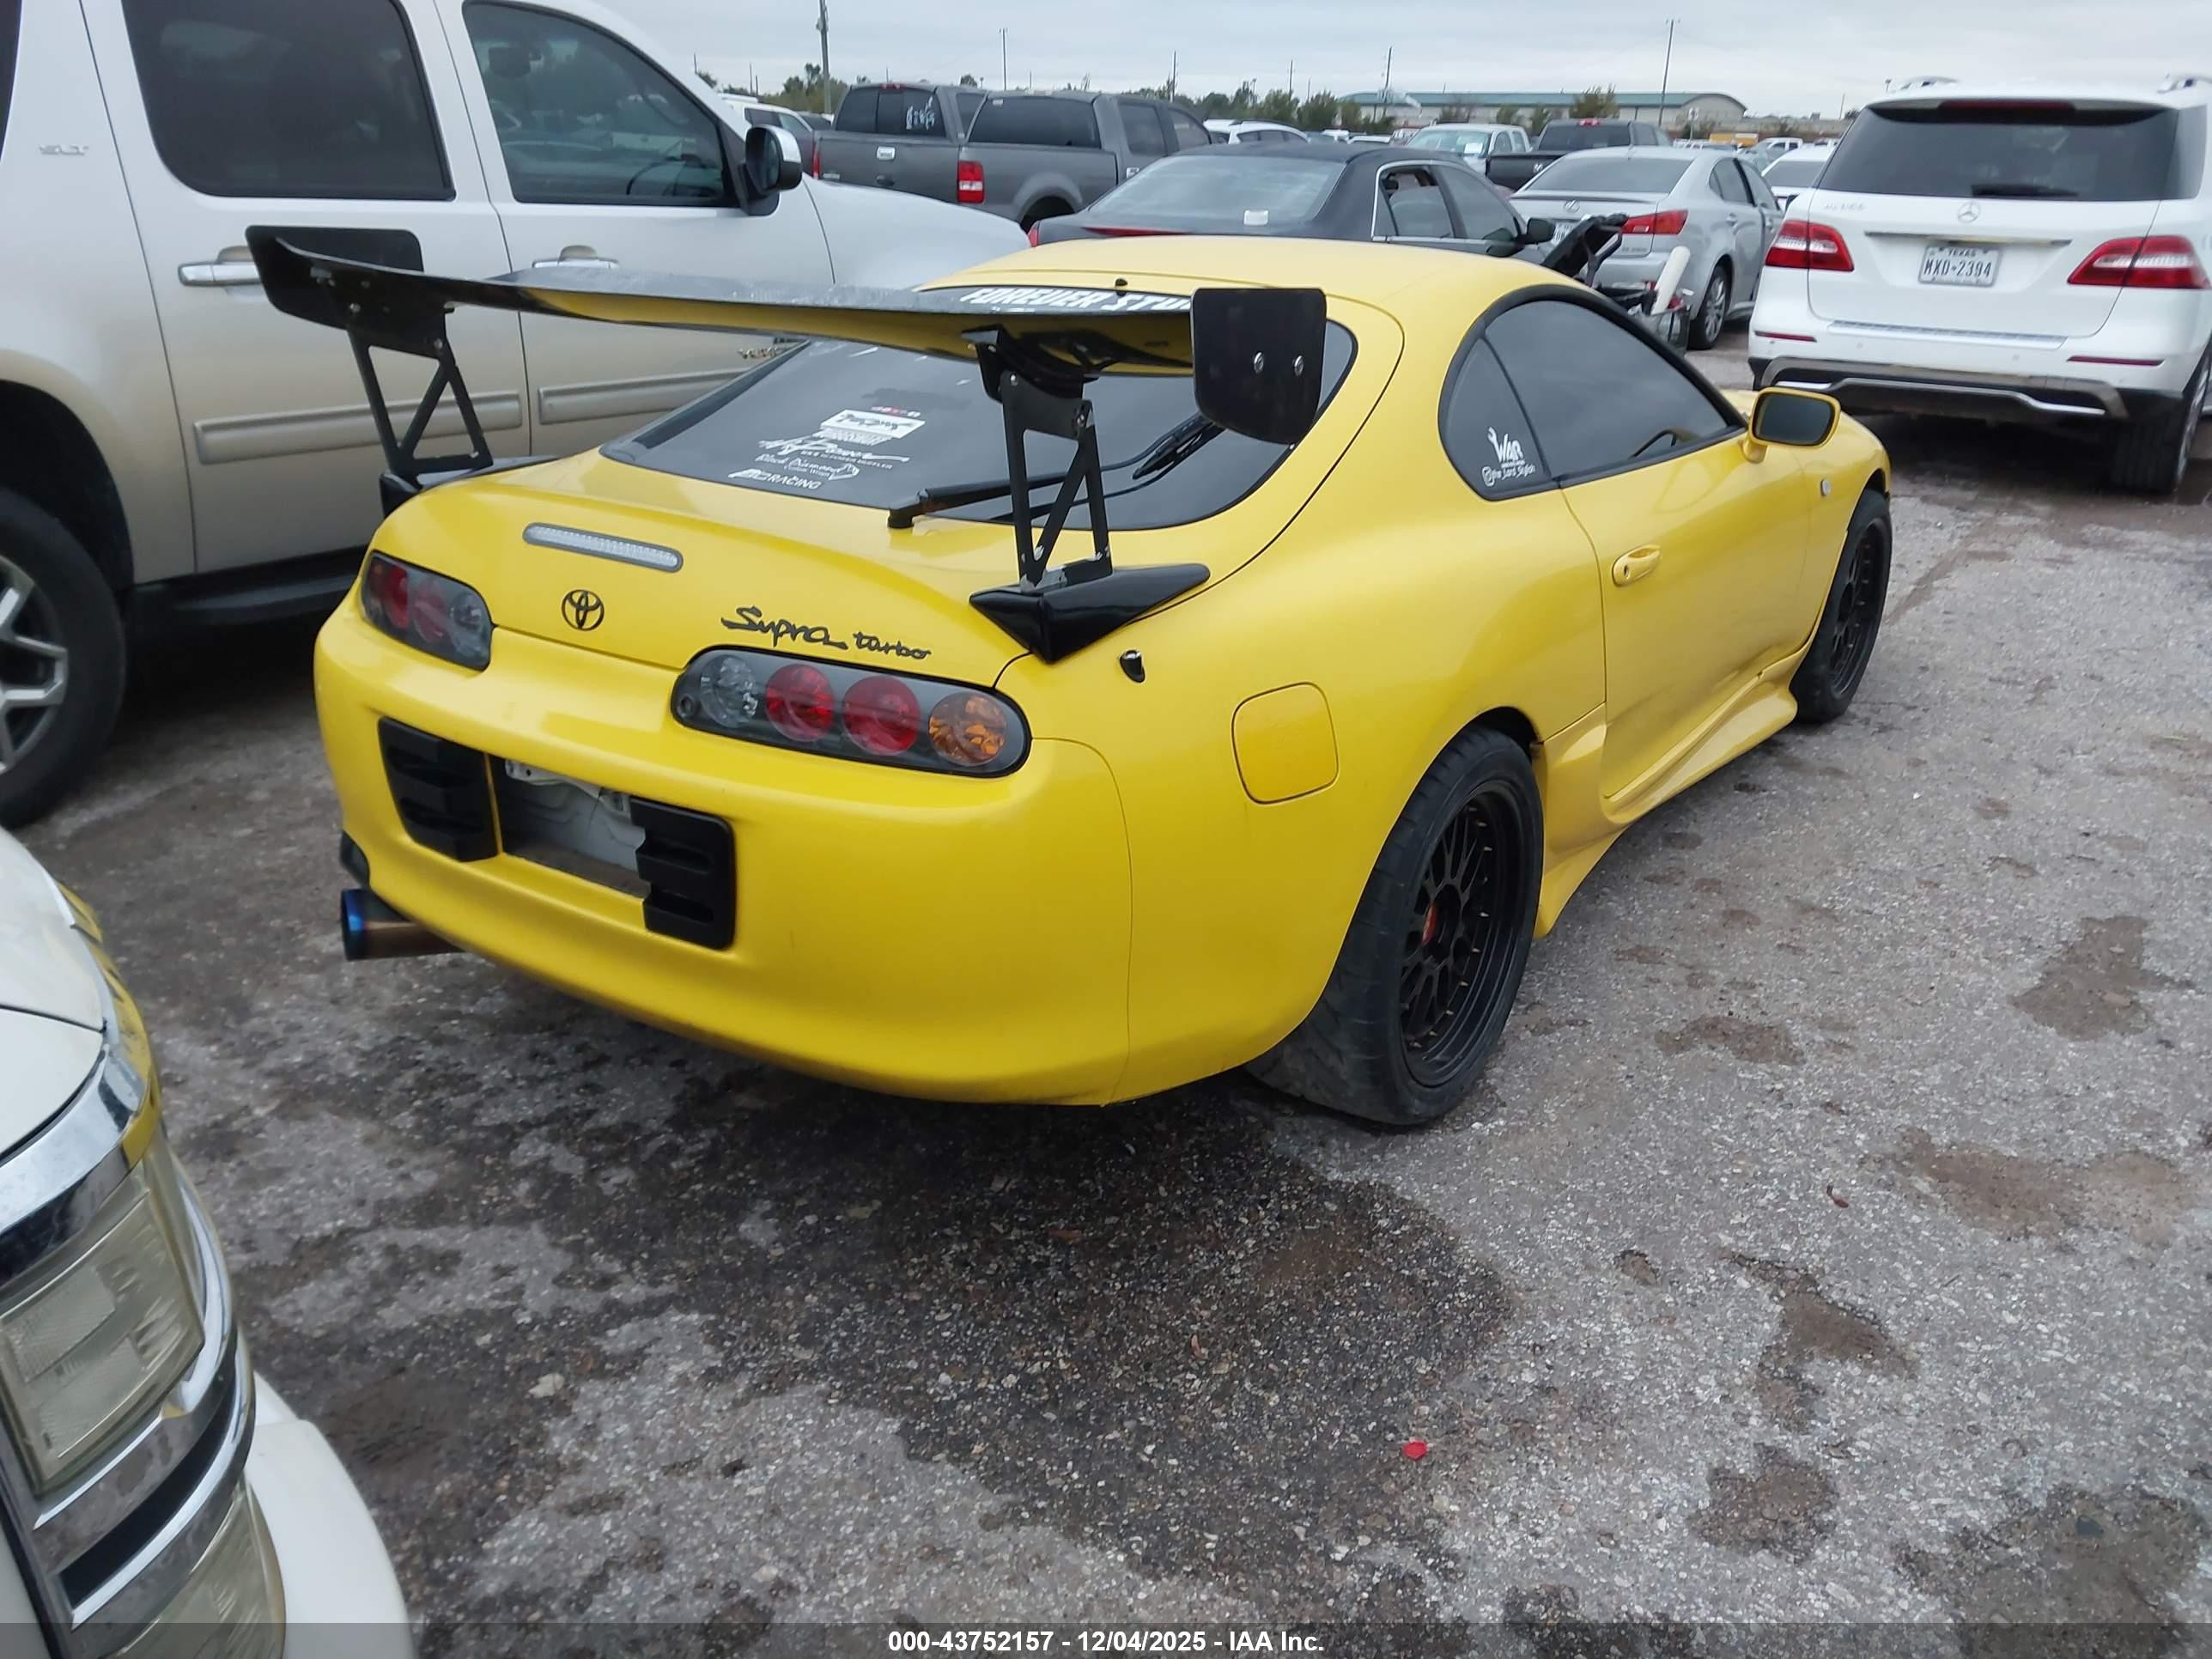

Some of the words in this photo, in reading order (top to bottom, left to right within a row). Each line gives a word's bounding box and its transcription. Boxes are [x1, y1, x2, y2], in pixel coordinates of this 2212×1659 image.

[1099, 294, 1191, 311] STU
[720, 605, 848, 650] Supra
[853, 632, 932, 659] turbo
